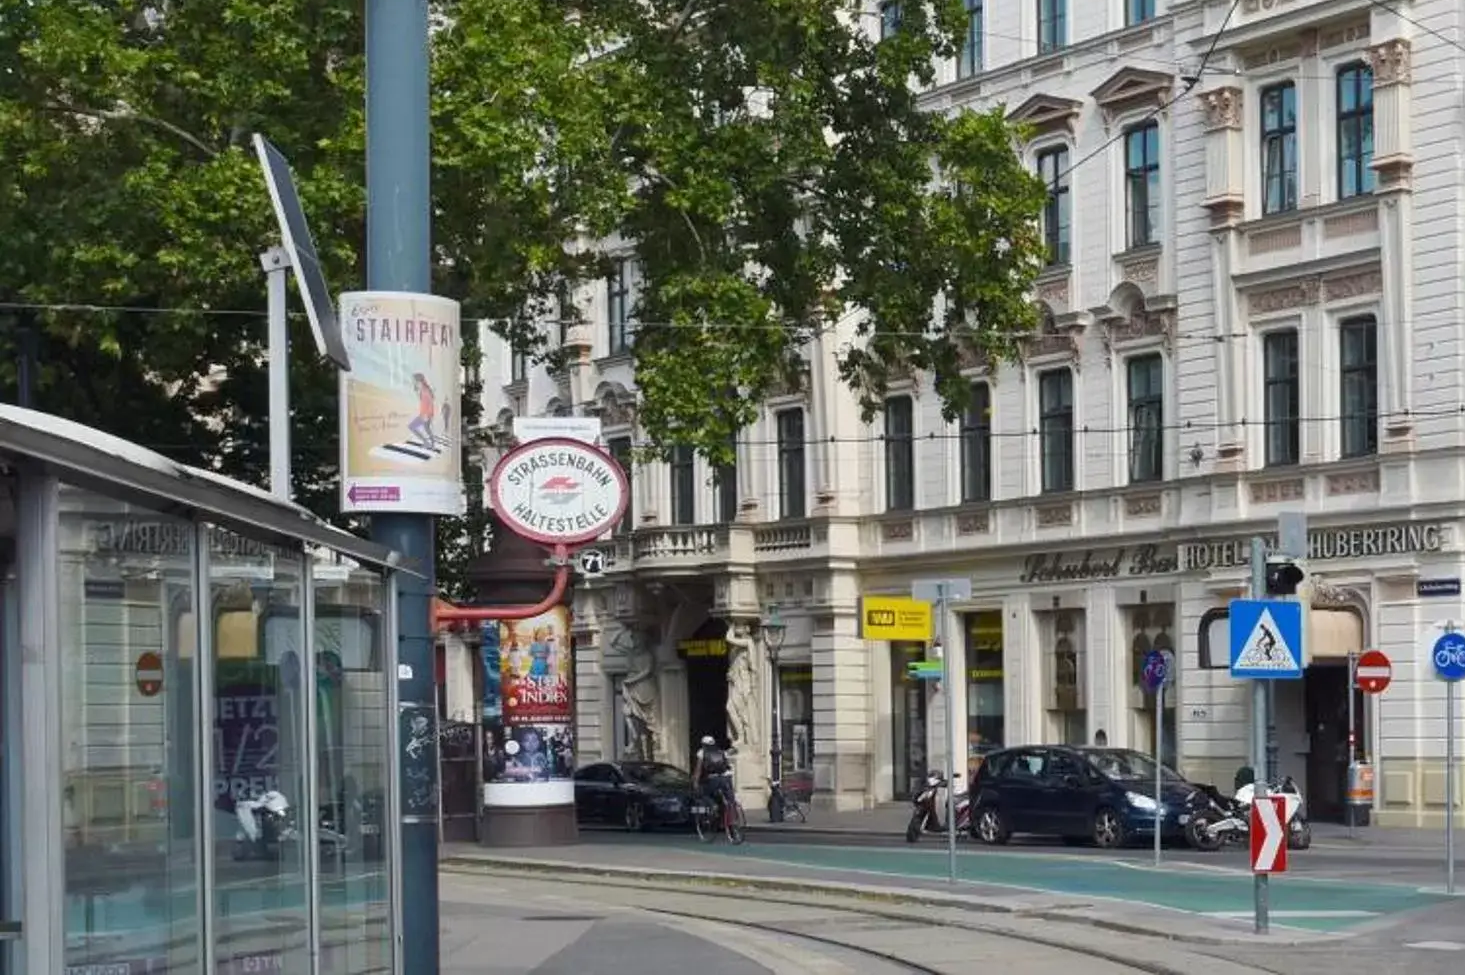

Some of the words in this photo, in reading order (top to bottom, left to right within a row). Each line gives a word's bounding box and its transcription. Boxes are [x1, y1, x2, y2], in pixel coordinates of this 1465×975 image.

[507, 452, 612, 487] STRASSENBAHN
[513, 502, 609, 532] HALTESTELLE
[584, 554, 603, 572] 71
[1185, 540, 1249, 570] HOTEL
[1308, 525, 1440, 559] HUBERTRING
[1020, 548, 1125, 582] Schubert
